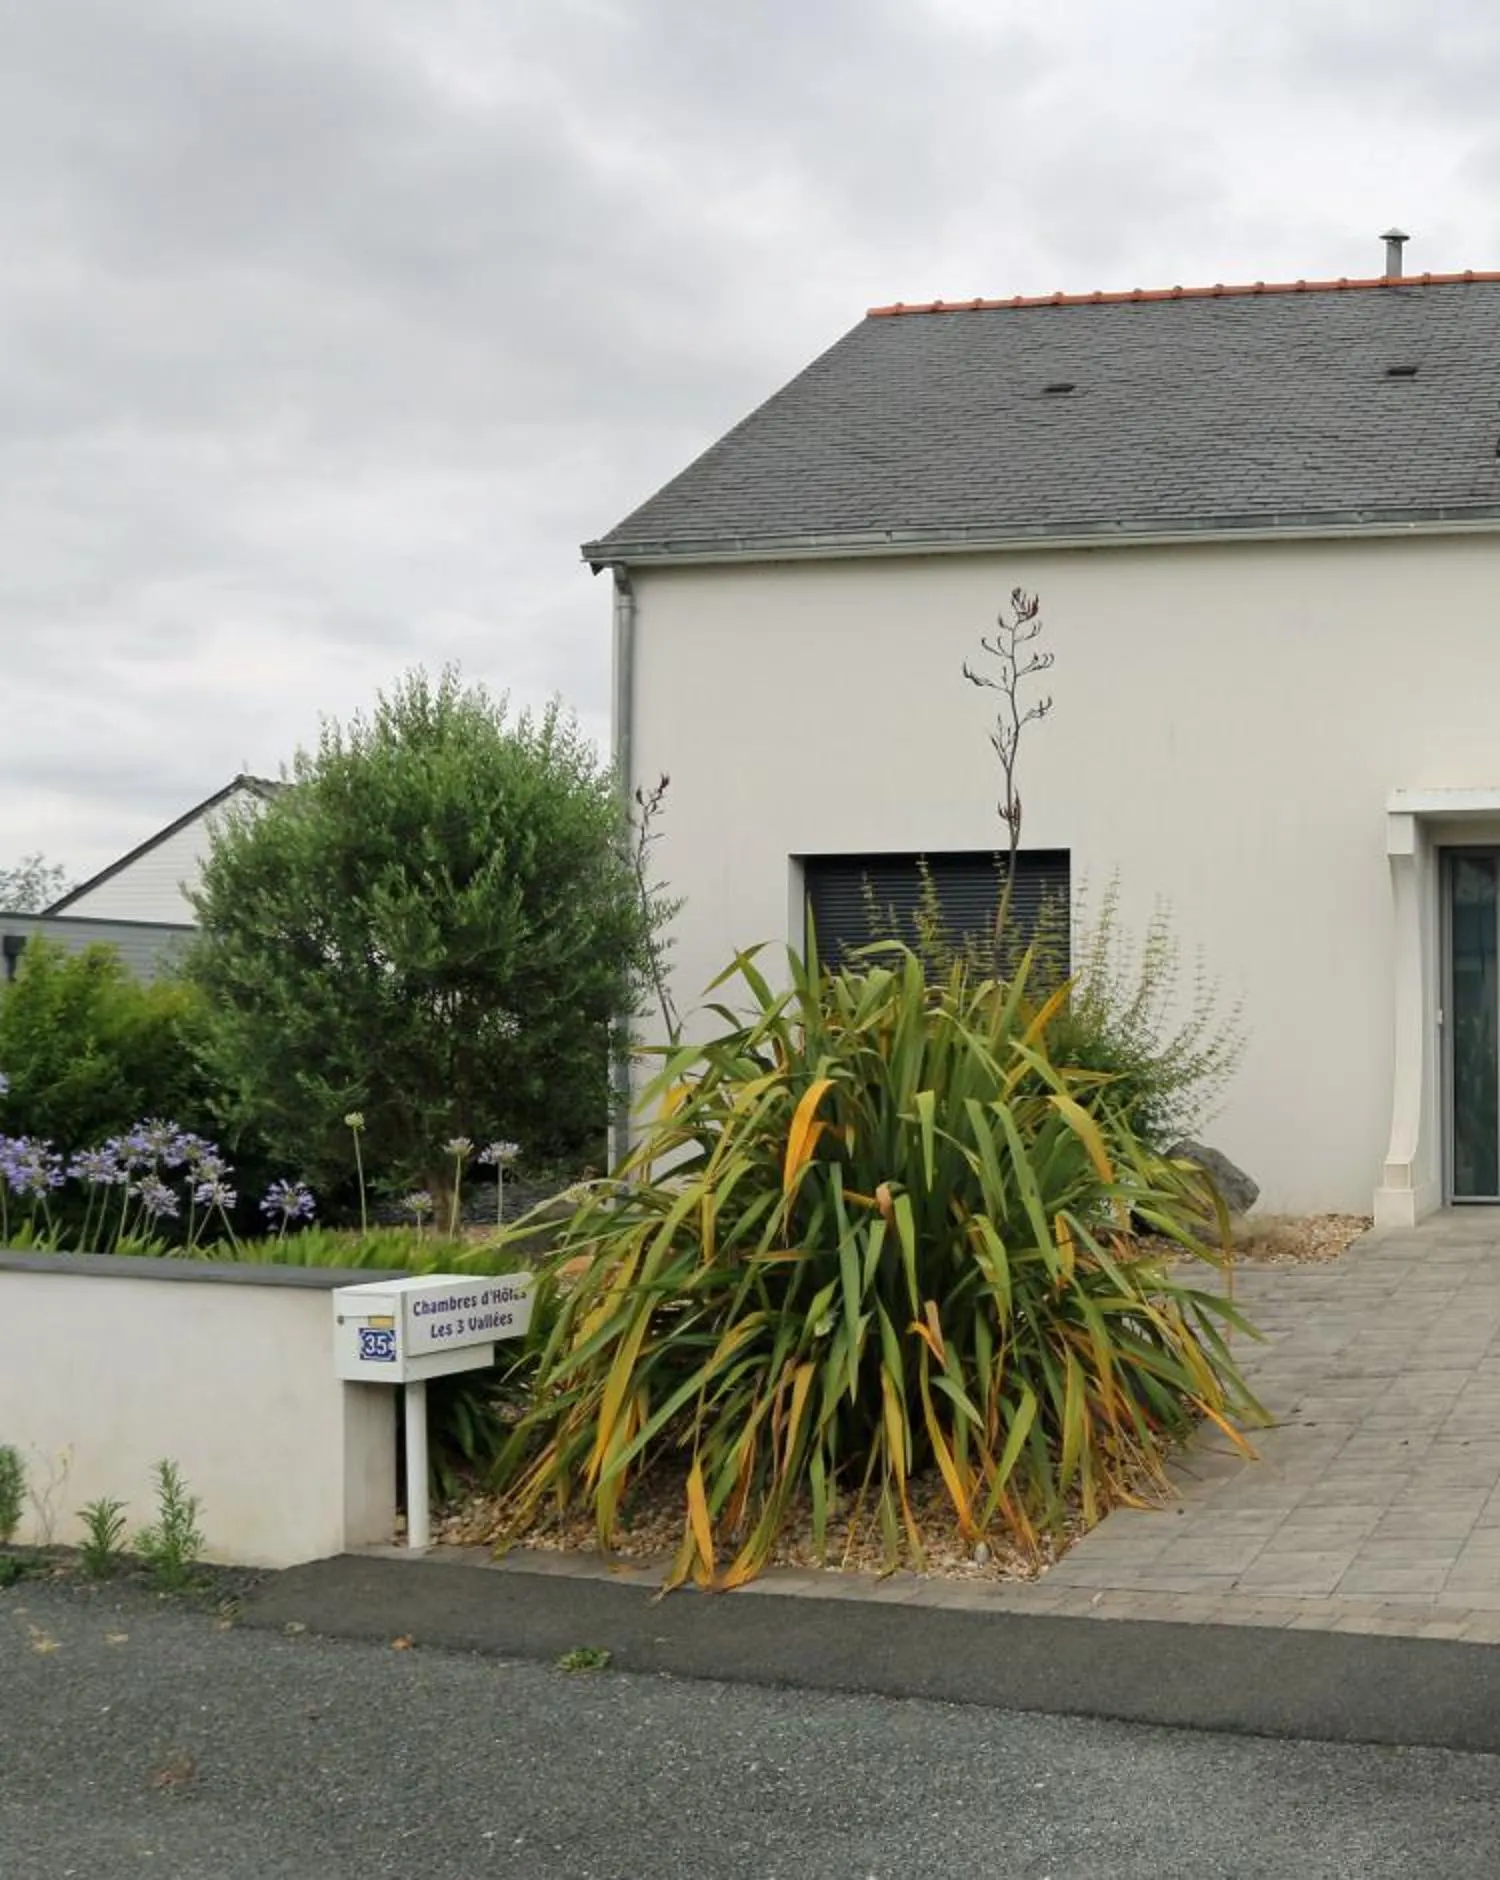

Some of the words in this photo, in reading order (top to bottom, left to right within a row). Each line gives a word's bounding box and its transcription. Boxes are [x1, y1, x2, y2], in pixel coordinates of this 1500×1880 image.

[413, 1295, 477, 1317] Chambres
[431, 1319, 453, 1338] Les
[456, 1319, 465, 1334] 3
[468, 1311, 513, 1331] Vallées
[364, 1334, 387, 1354] 35
